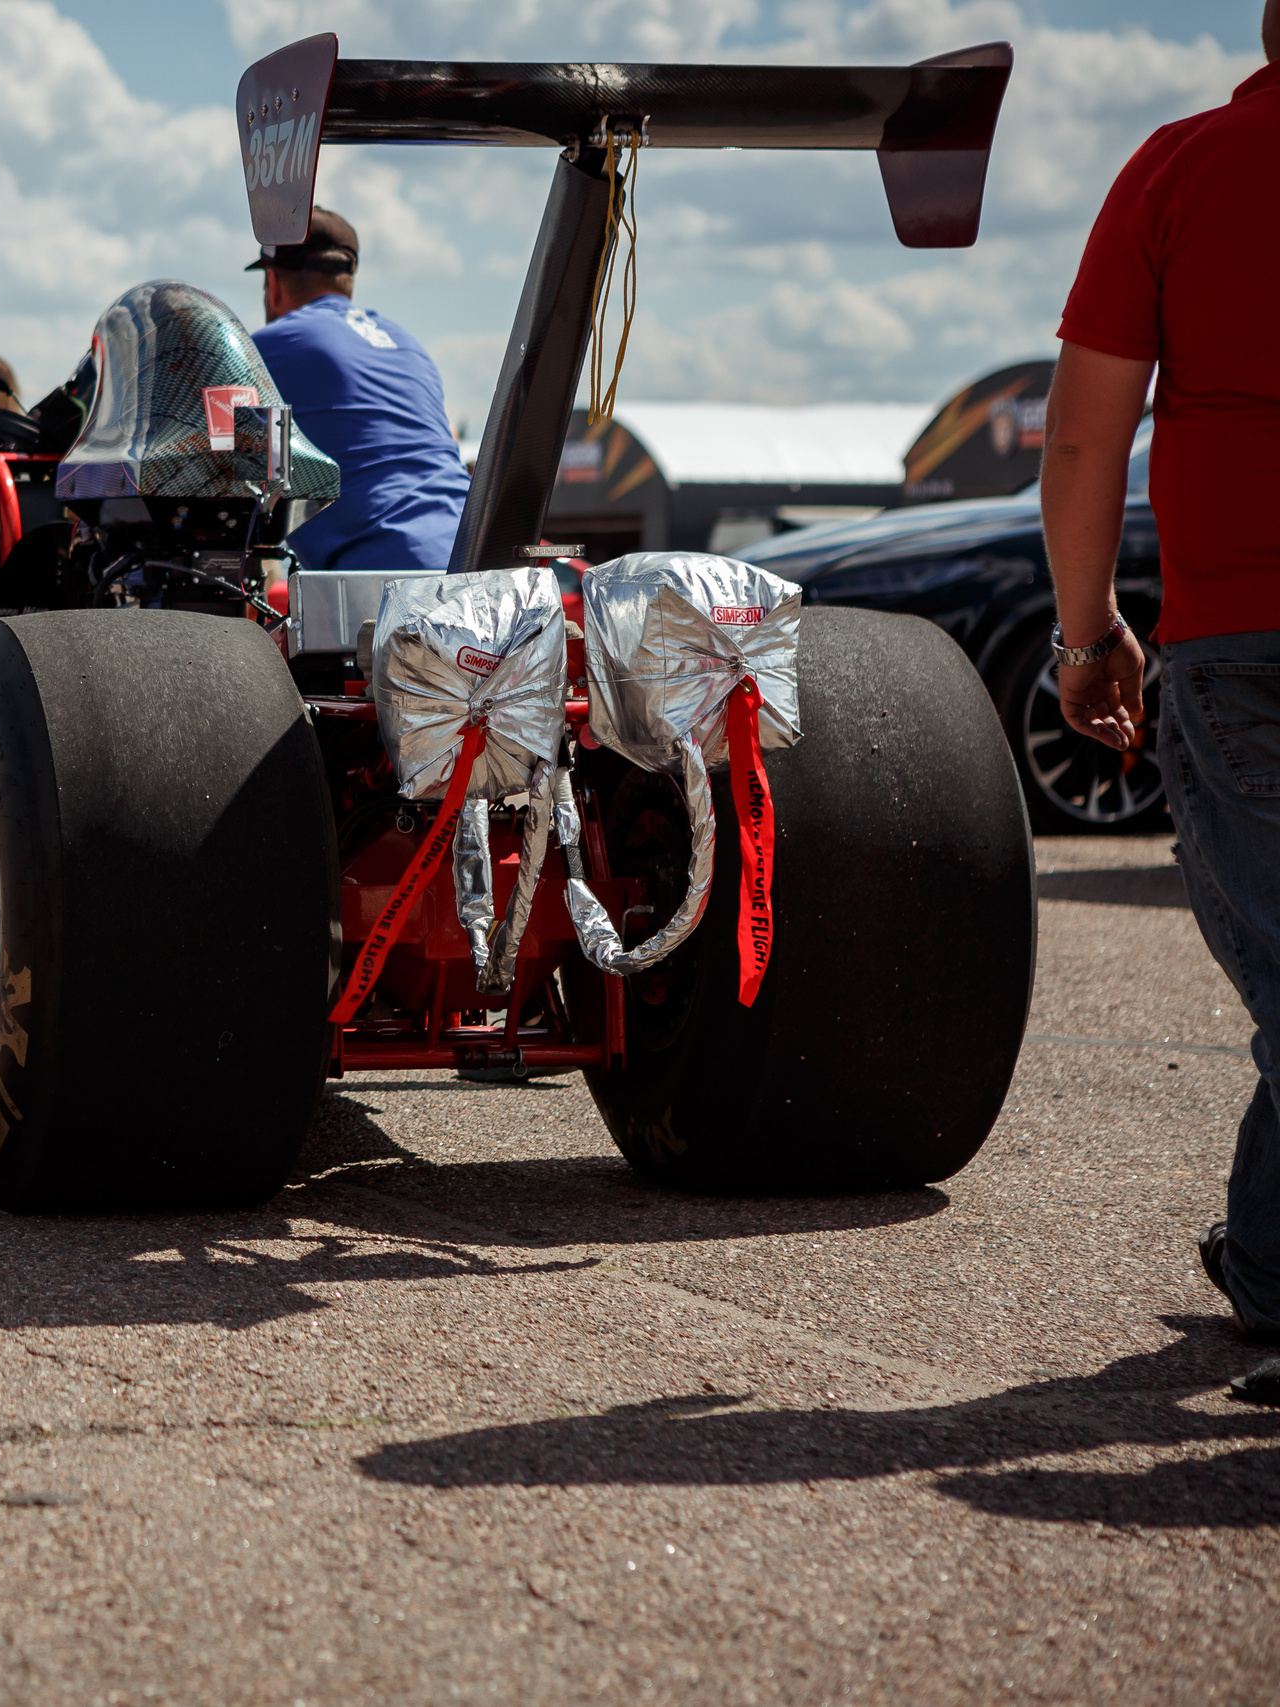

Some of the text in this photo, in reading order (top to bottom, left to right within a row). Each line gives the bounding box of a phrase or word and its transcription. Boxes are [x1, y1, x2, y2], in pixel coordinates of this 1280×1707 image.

[246, 111, 316, 192] 357M
[210, 396, 234, 418] FLAMMA
[716, 608, 761, 623] SIMPSON
[464, 653, 500, 672] SIMPSO
[358, 934, 388, 992] FLIGHT
